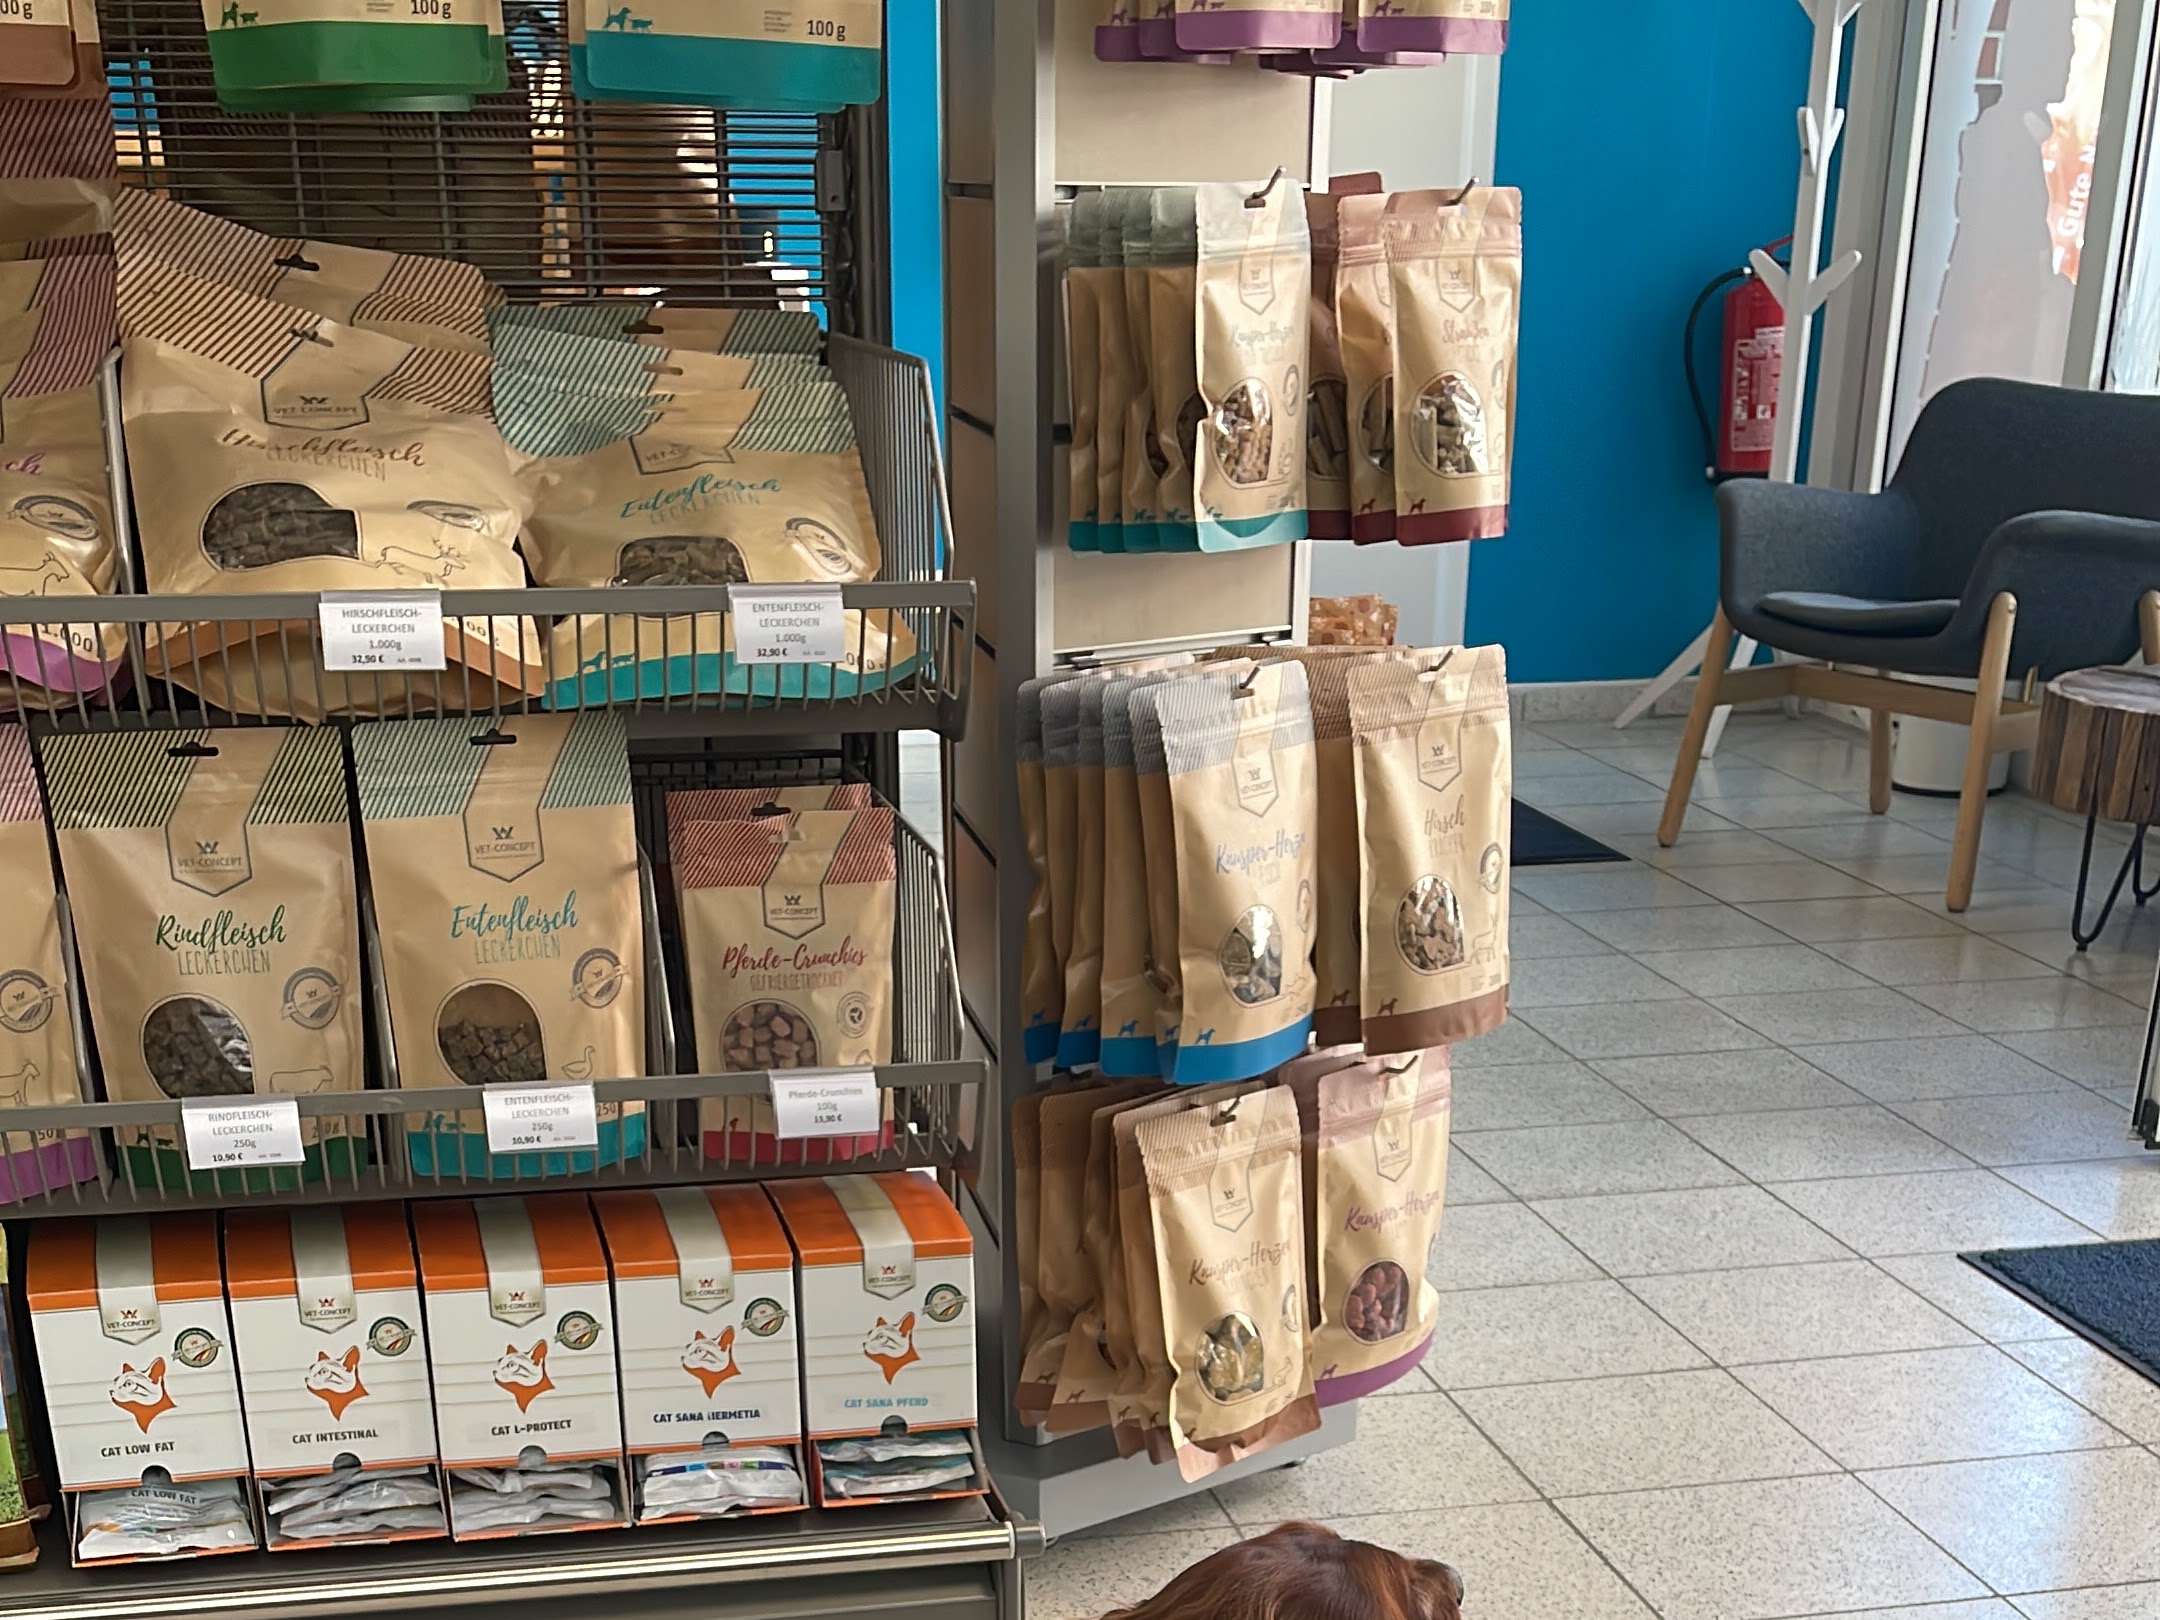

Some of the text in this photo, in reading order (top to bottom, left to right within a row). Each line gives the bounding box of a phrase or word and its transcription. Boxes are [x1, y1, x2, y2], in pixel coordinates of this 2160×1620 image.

[0, 0, 33, 20] 00 g
[411, 0, 439, 15] 100
[442, 2, 452, 19] g
[807, 19, 834, 37] 100
[837, 24, 846, 42] g
[341, 608, 423, 619] HIRSCHFLEISCH-
[351, 623, 416, 634] LECKERCHEN
[759, 617, 820, 628] LECKERCHEN
[474, 841, 536, 854] VET-CONCEPT
[450, 888, 578, 942] Entenfleisch
[155, 903, 287, 955] Rindfleisch
[176, 950, 271, 976] LECKERCHEN
[208, 1109, 273, 1122] RINDFLEISCH-
[511, 1106, 570, 1119] LECKERCHEN
[212, 1123, 273, 1136] LECKERCHEN
[233, 1138, 257, 1149] 250g
[237, 1152, 244, 1161] €
[106, 1317, 156, 1330] VET-CONCEPT
[844, 1397, 929, 1409] CAT SANA PFERD
[653, 1413, 673, 1424] CAT
[676, 1412, 704, 1423] SANA
[491, 1419, 572, 1437] CAT L-PROTECT
[291, 1428, 379, 1445] CAT INTESTINAL
[100, 1441, 176, 1458] CAT LOW FAT
[131, 1489, 197, 1505] CAT LOW FAT
